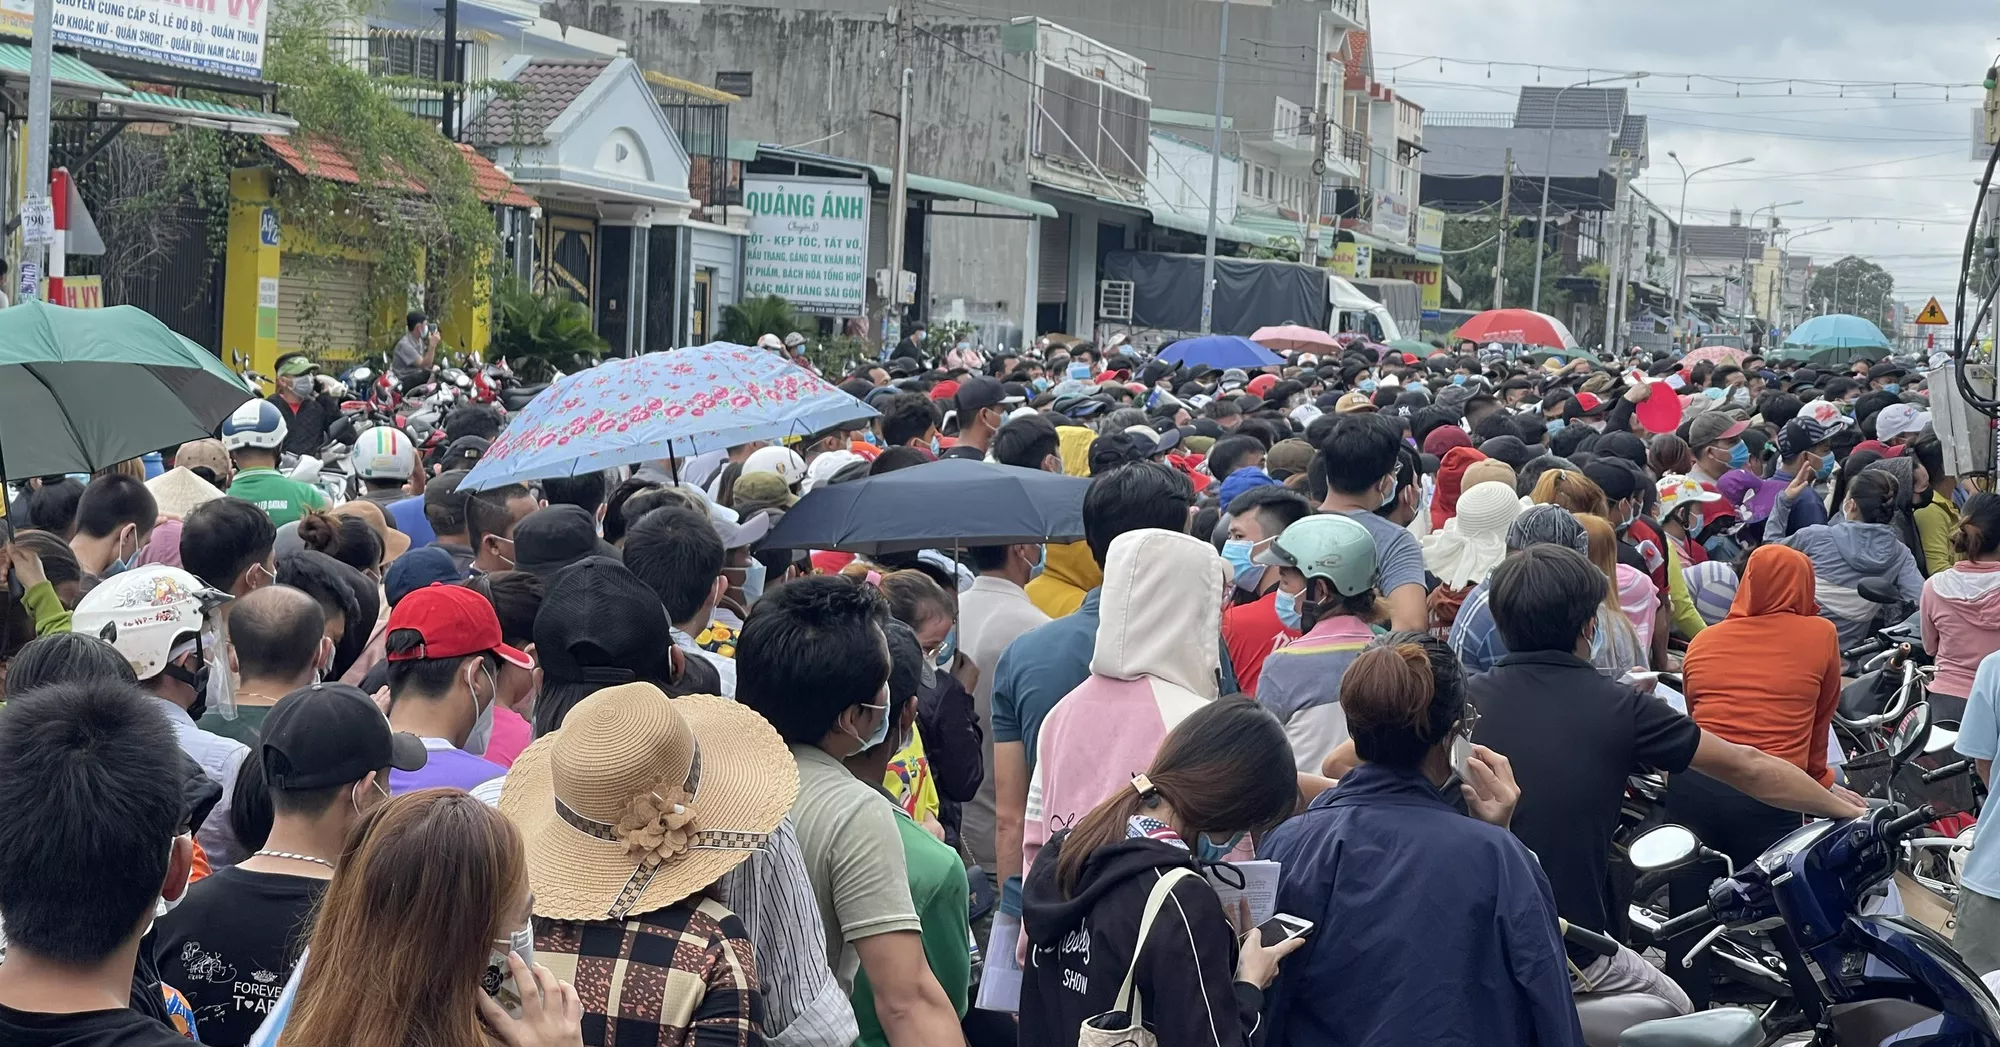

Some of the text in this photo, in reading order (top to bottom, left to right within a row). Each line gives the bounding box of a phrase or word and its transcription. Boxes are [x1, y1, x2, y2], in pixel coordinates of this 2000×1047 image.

[98, 2, 124, 18] CUNG
[237, 30, 259, 45] THUN
[139, 30, 164, 46] SHORT
[207, 43, 224, 58] NAM
[746, 184, 863, 219] QUẢNG ÁNH
[24, 215, 44, 226] 790
[774, 235, 794, 247] KẸP
[1402, 269, 1438, 286] THU
[233, 981, 283, 999] FOREVE
[1062, 968, 1088, 995] SHOW
